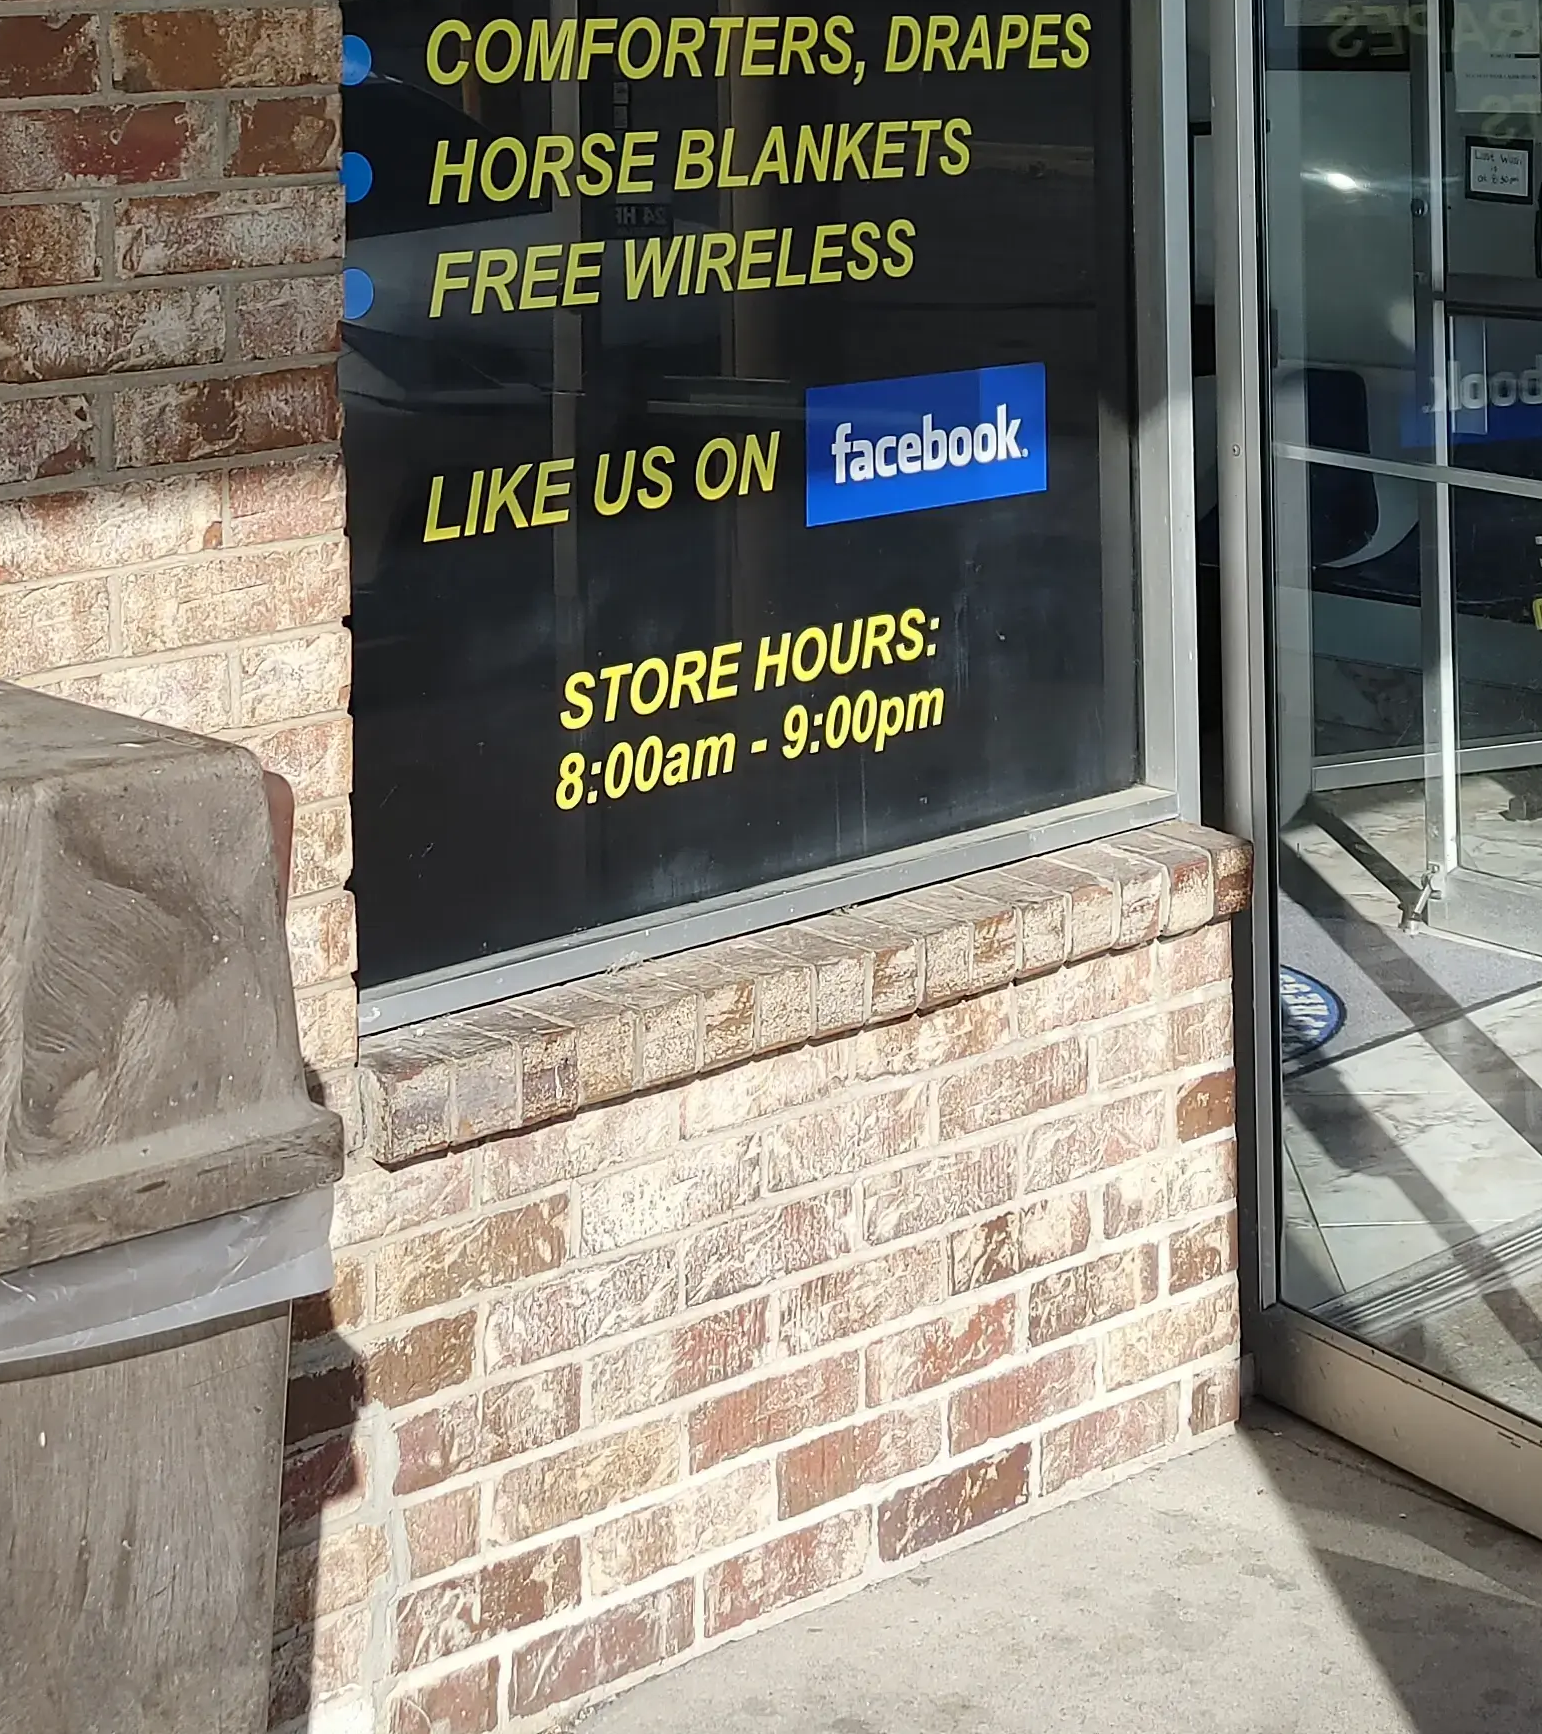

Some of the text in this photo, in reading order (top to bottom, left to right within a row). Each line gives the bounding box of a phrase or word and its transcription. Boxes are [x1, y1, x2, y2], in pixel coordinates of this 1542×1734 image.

[426, 13, 1091, 86] COMFORTERS, DRAPES
[428, 118, 973, 205] HORSE BLANKETS
[428, 219, 917, 319] FREE WIRELESS
[423, 430, 780, 543] LIKE US ON
[560, 608, 941, 729] STORE HOURS:
[555, 730, 736, 811] 8:00am
[782, 687, 945, 760] 9:00pm
